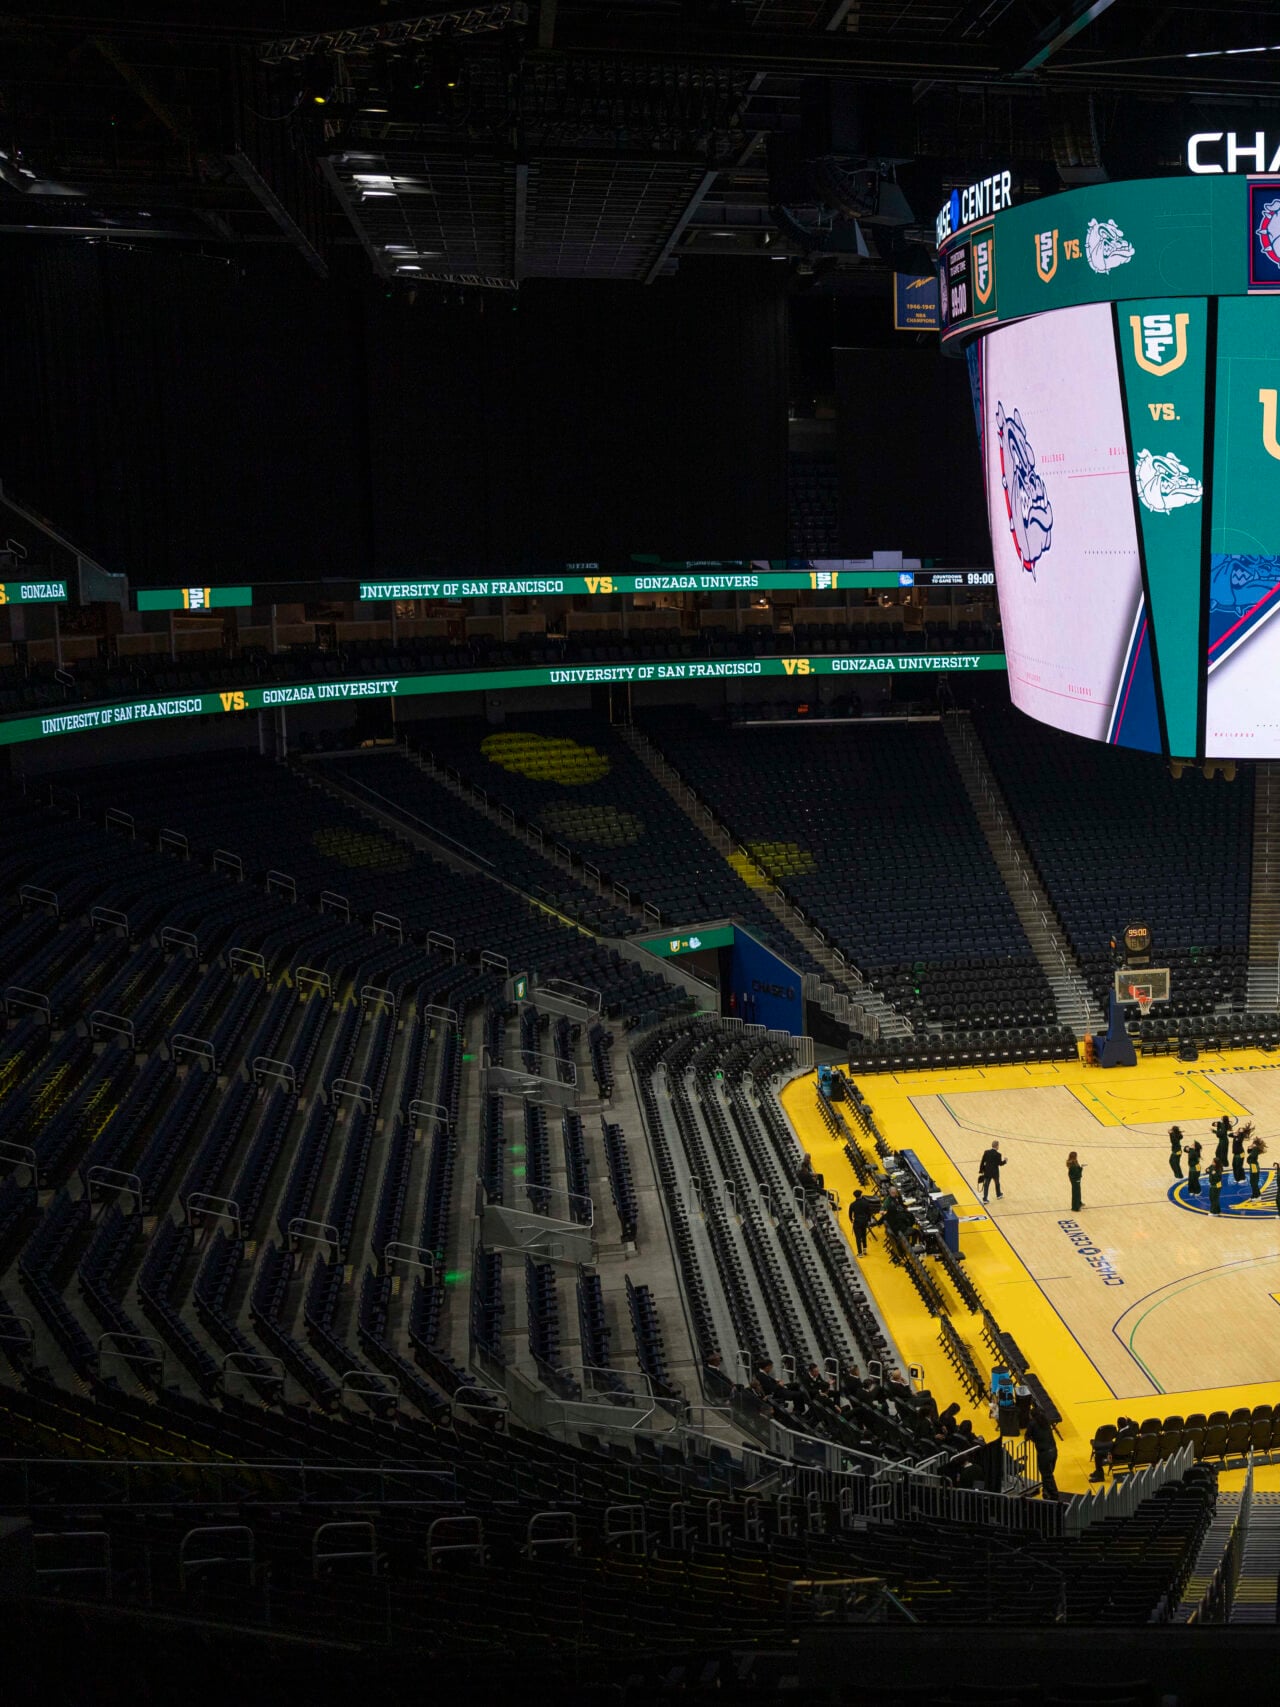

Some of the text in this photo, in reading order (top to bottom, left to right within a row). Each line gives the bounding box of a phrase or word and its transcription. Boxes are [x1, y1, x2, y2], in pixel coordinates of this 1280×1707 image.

[962, 170, 1012, 224] CENTER
[1063, 239, 1082, 260] VS.
[1148, 403, 1180, 421] VS.
[443, 583, 458, 596] OF
[462, 582, 489, 595] SAN
[491, 580, 563, 594] FRANCISCO
[584, 577, 617, 593] VS.
[634, 576, 697, 590] GONZAGA
[701, 575, 758, 587] UNIVERS
[967, 573, 994, 584] 99:00
[21, 584, 65, 599] GONZAGA
[550, 657, 980, 683] UNIVERSITY OF SAN FRANCISCO VS. GONZAGA UNIVERSITY
[42, 680, 398, 735] UNIVERSITY OF SAN FRANCISCO VS. GONZAGA UNIVERSITY
[1173, 1068, 1215, 1076] SAN
[1057, 1219, 1125, 1286] CHASE CENTER
